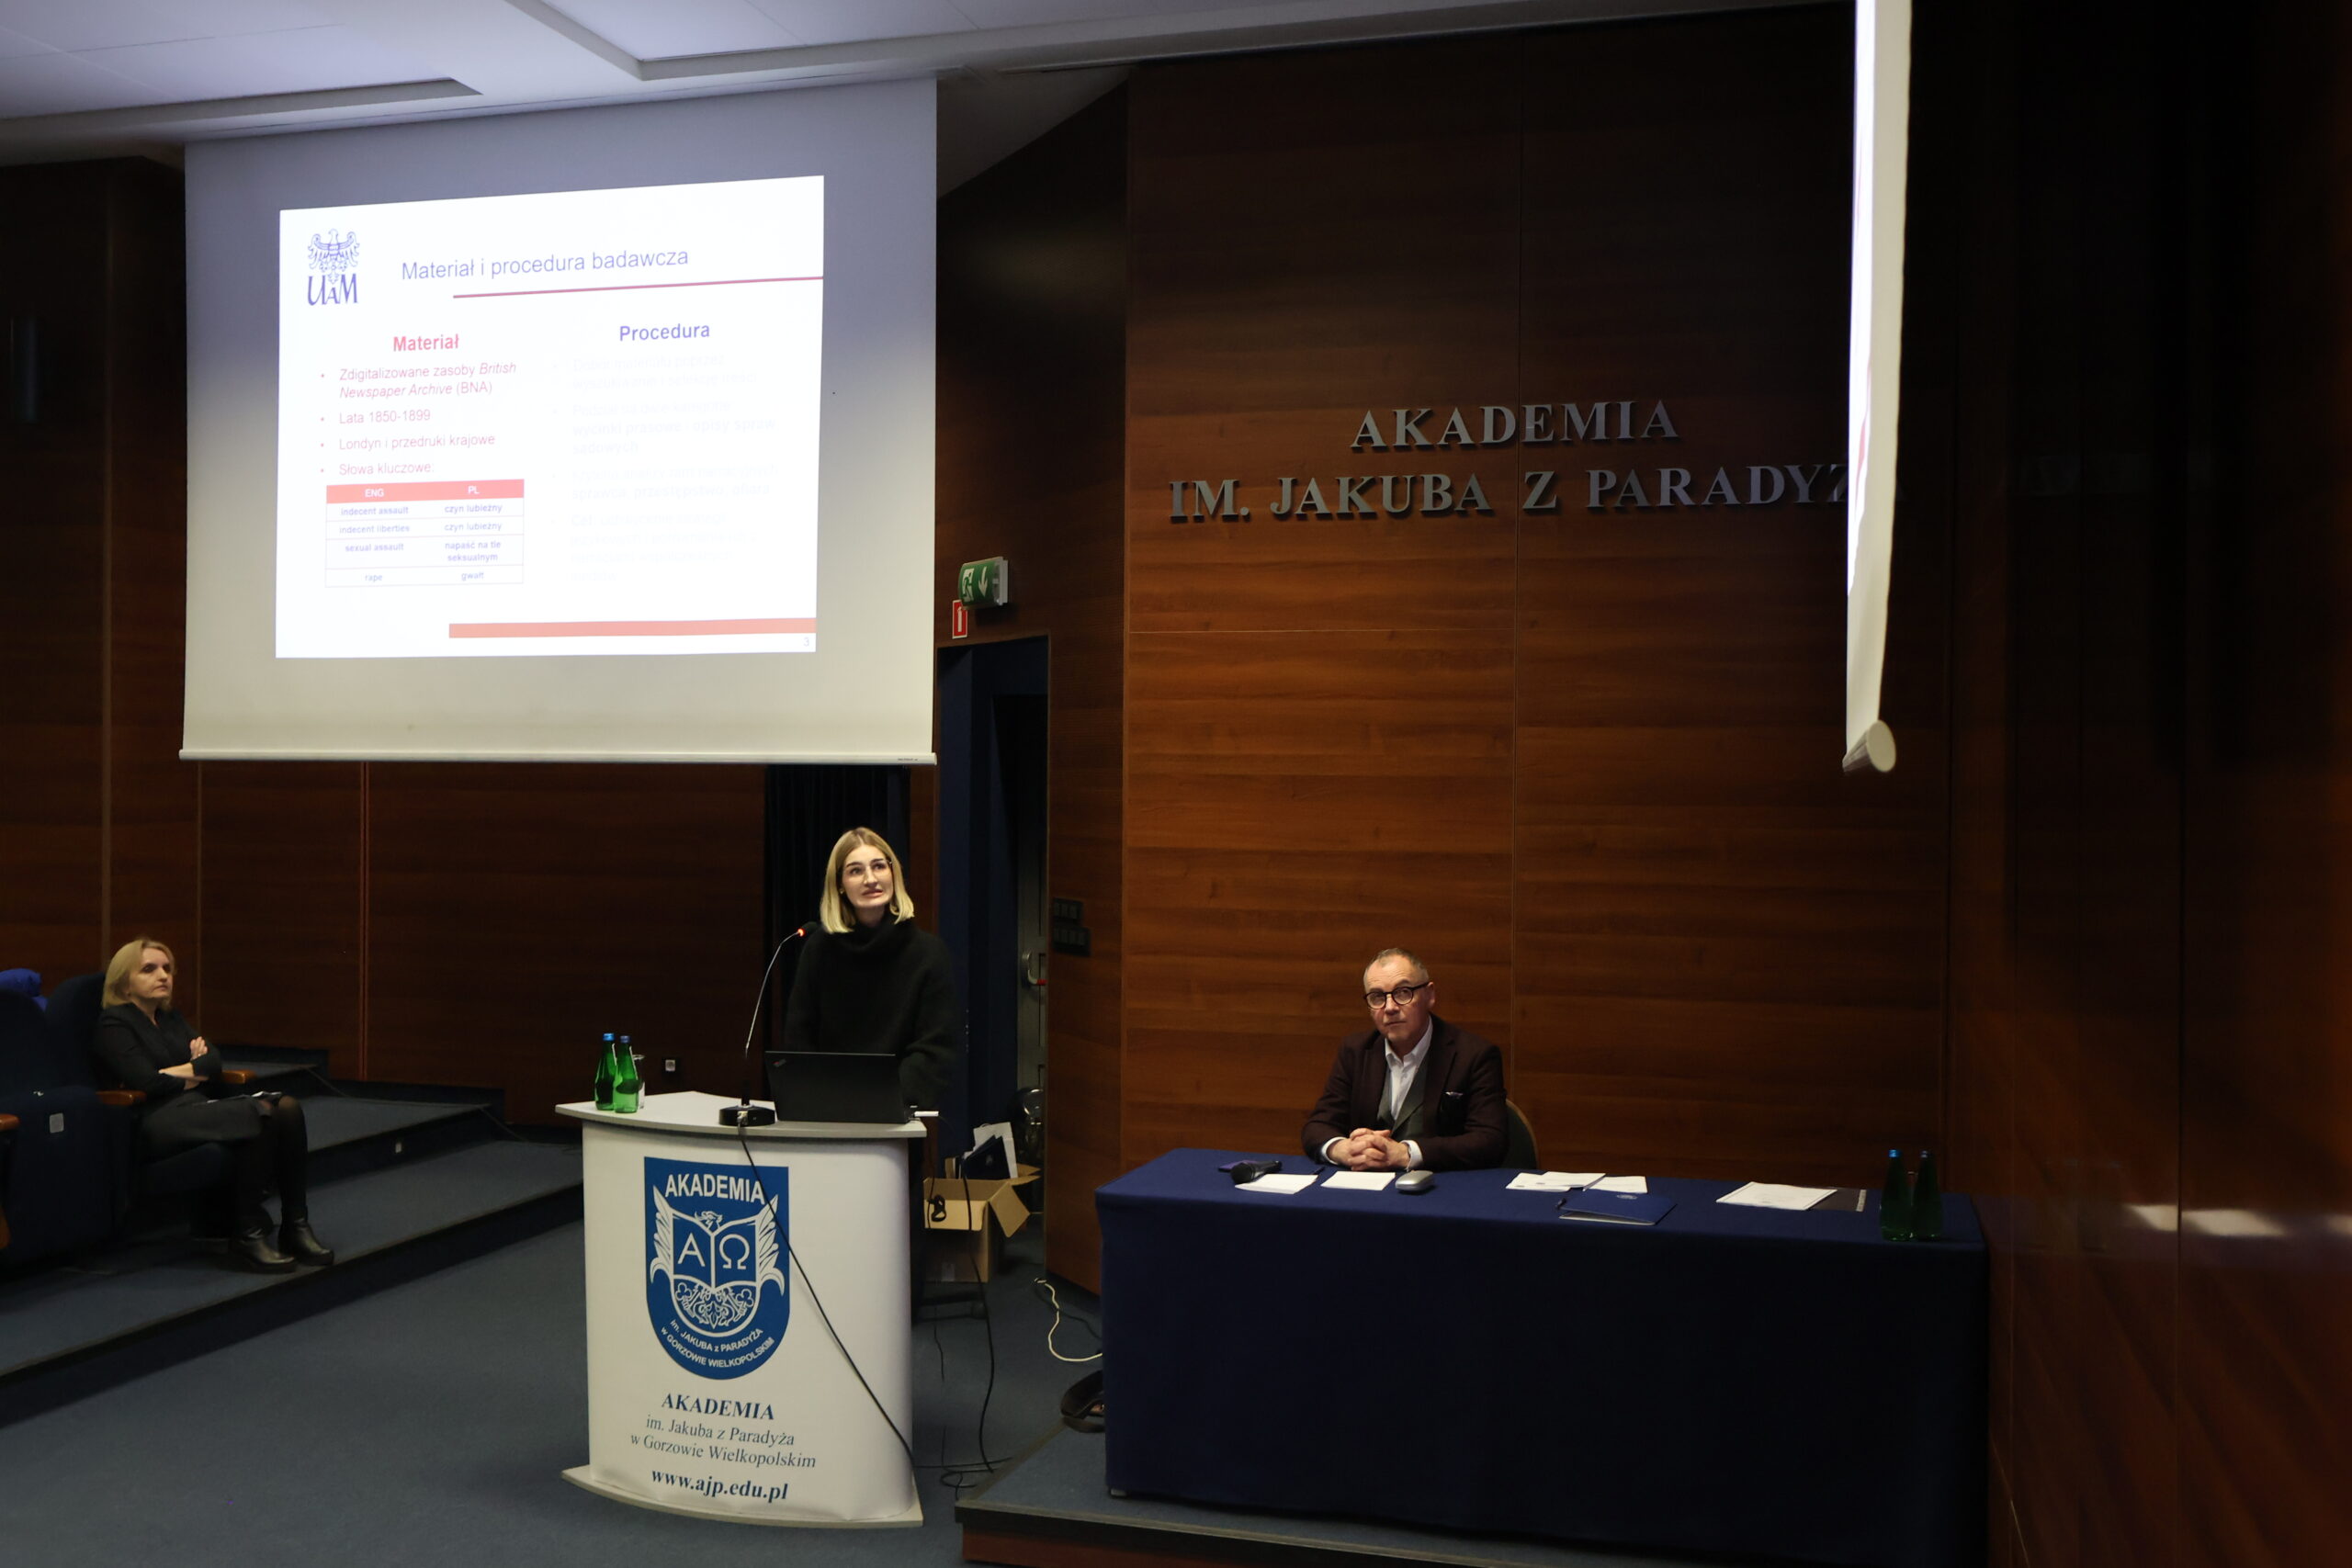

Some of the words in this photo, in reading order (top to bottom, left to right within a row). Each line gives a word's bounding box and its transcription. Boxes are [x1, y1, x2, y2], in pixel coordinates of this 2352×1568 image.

[401, 259, 475, 280] Materiał
[480, 258, 485, 277] i
[492, 254, 585, 279] procedura
[592, 250, 689, 271] badawcza
[392, 333, 460, 353] Materiał
[619, 323, 710, 343] Procedura
[339, 367, 430, 383] Zdigitalizowane
[433, 364, 475, 378] zasoby
[479, 362, 516, 375] British
[339, 385, 406, 400] Newspaper
[408, 383, 453, 396] Archive
[457, 380, 492, 396] (BNA)
[339, 412, 365, 424] Lata
[369, 409, 431, 423] 1850-1899
[1351, 400, 1679, 448] AKADEMIA
[339, 438, 381, 452] Londyn
[385, 437, 389, 447] i
[391, 434, 446, 451] przedruki
[449, 434, 495, 448] krajowe
[339, 462, 374, 475] Słowa
[378, 461, 435, 474] kluczowe:
[365, 488, 385, 498] ENG
[468, 486, 481, 495] PL
[1170, 479, 1250, 518] IM.
[1270, 473, 1493, 516] JAKUBA
[1521, 470, 1558, 510] Z
[341, 506, 377, 516] indecent
[379, 506, 409, 515] assault
[445, 505, 464, 514] czyn
[467, 503, 503, 514] lubieżny
[339, 525, 374, 535] indecent
[377, 524, 410, 533] liberties
[445, 523, 464, 533] czyn
[467, 522, 503, 532] lubieżny
[345, 543, 371, 552] sexual
[374, 542, 404, 551] assault
[478, 541, 489, 549] na
[447, 553, 498, 563] seksualnym
[365, 573, 383, 583] rape
[665, 1174, 765, 1205] AKADEMIA
[670, 1319, 680, 1334] im.
[681, 1331, 712, 1352] JAKUBA
[720, 1327, 763, 1352] PARADYŻA
[661, 1326, 668, 1336] w
[667, 1335, 707, 1366] GORZOWIE
[708, 1337, 775, 1368] WIELKOPOLSKIM
[662, 1393, 775, 1420] AKADEMIA
[646, 1414, 664, 1431] im.
[668, 1418, 713, 1439] Jakuba
[717, 1429, 726, 1440] z
[729, 1427, 795, 1448] Paradyża
[631, 1434, 641, 1445] w
[643, 1434, 704, 1458] Gorzowie
[708, 1445, 816, 1468] Wielkopolskim
[651, 1470, 788, 1503] www.ajp.edu.pl
